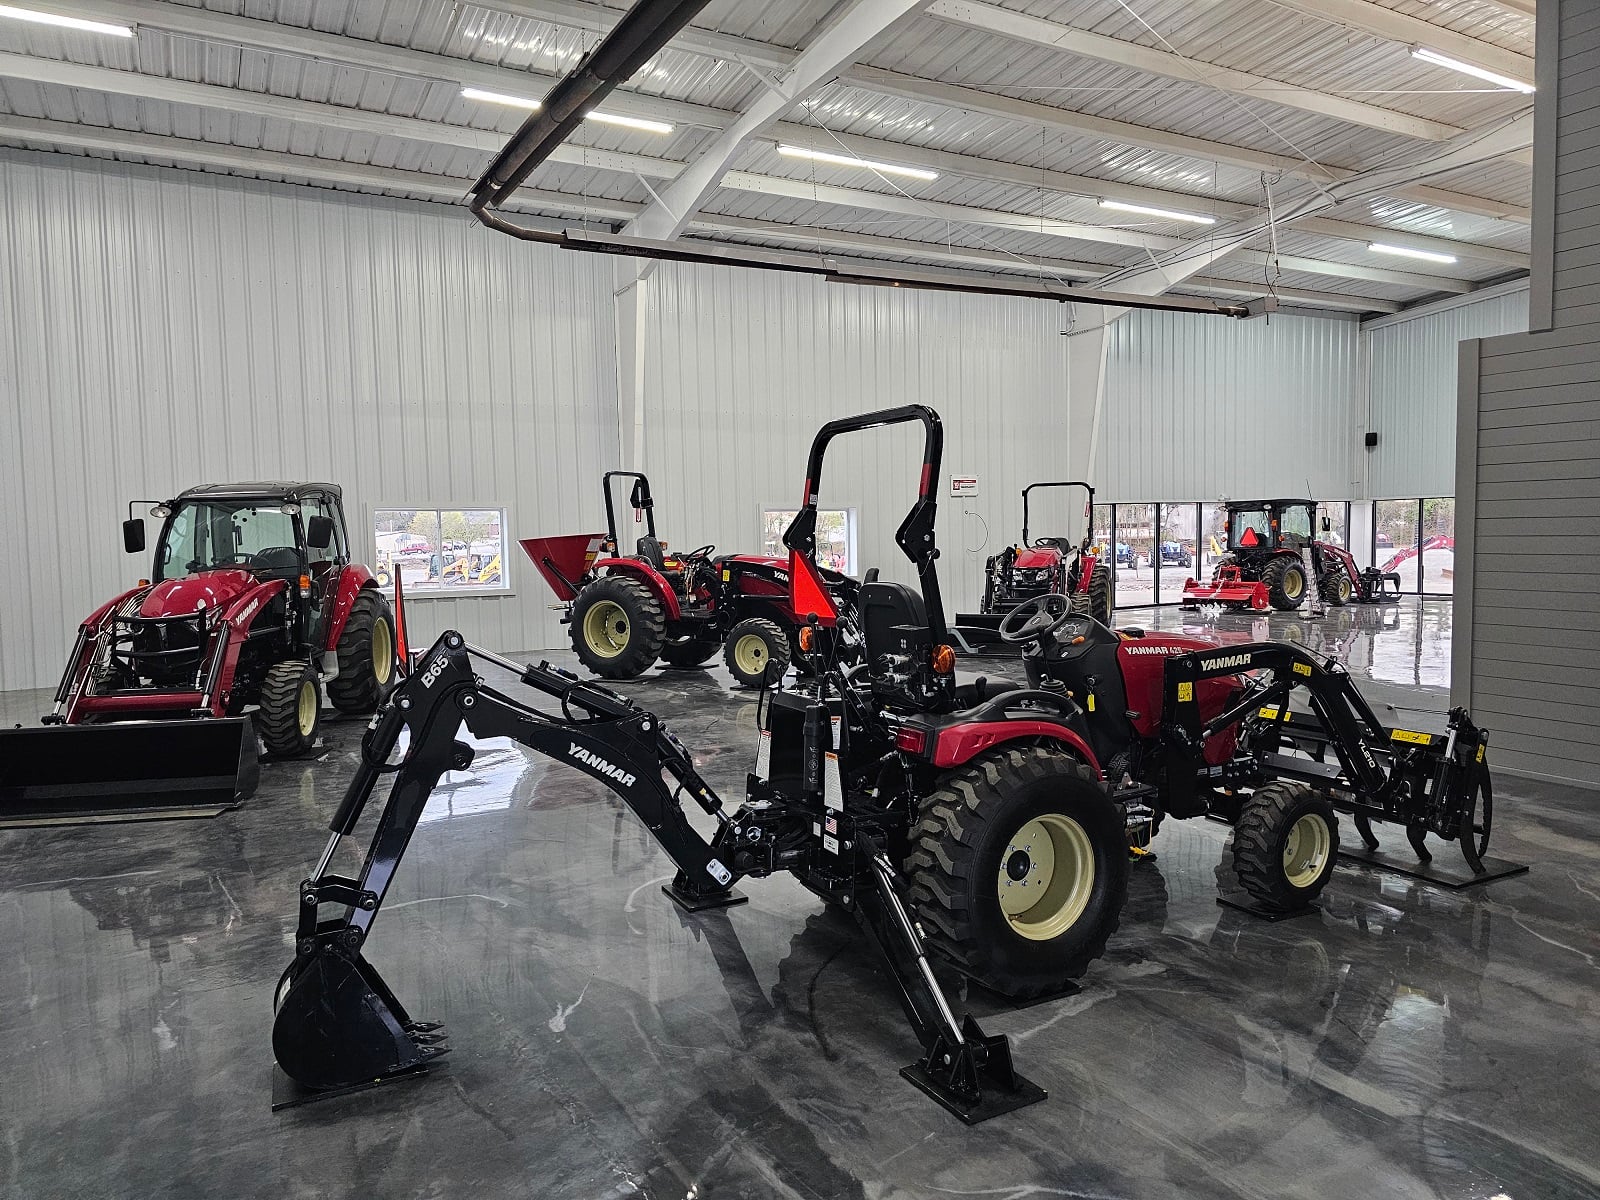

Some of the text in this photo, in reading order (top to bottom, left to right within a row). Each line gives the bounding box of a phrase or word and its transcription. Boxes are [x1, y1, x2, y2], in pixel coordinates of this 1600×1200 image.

[774, 570, 789, 582] YAN
[235, 597, 259, 626] YANMAR
[1125, 646, 1169, 655] YANMAR
[1200, 653, 1252, 672] YANMAR
[420, 655, 449, 689] B65
[568, 741, 637, 787] YANMAR
[1358, 738, 1376, 768] YL210
